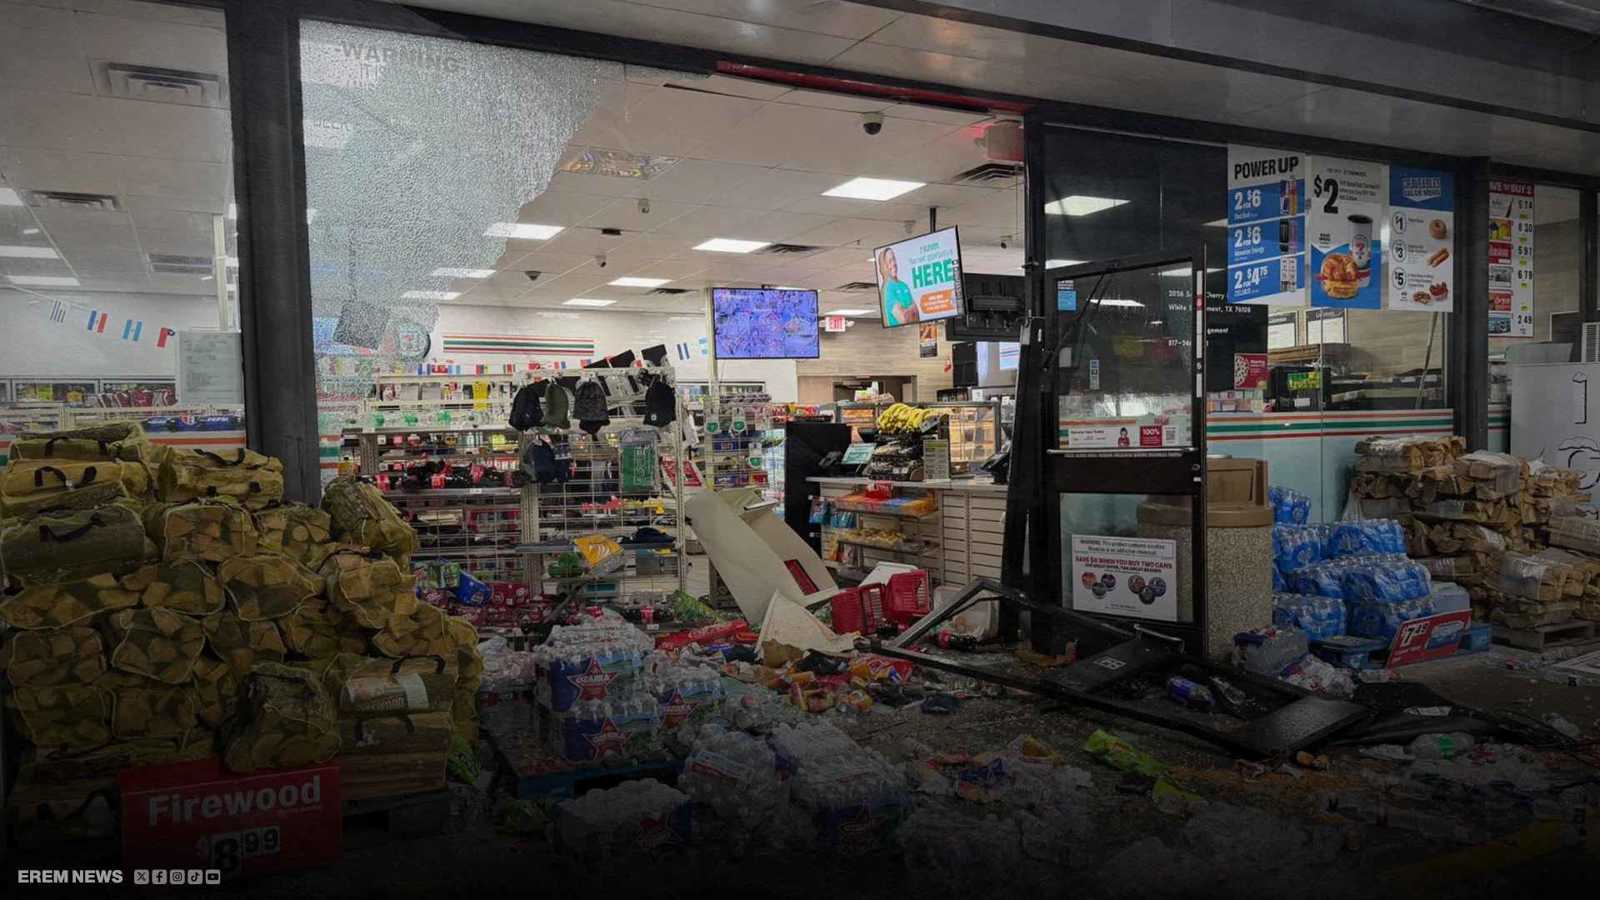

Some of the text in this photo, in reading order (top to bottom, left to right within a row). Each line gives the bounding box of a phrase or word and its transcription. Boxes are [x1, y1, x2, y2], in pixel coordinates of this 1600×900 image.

[1235, 156, 1299, 180] POWER UP
[1235, 192, 1243, 210] 2
[1247, 189, 1261, 208] $6
[1314, 174, 1338, 214] $2
[1235, 229, 1243, 248] 2
[1247, 226, 1261, 245] $6
[912, 257, 953, 288] HERE
[1235, 271, 1243, 290] 2
[1168, 304, 1187, 312] White
[149, 776, 320, 825] Firewood
